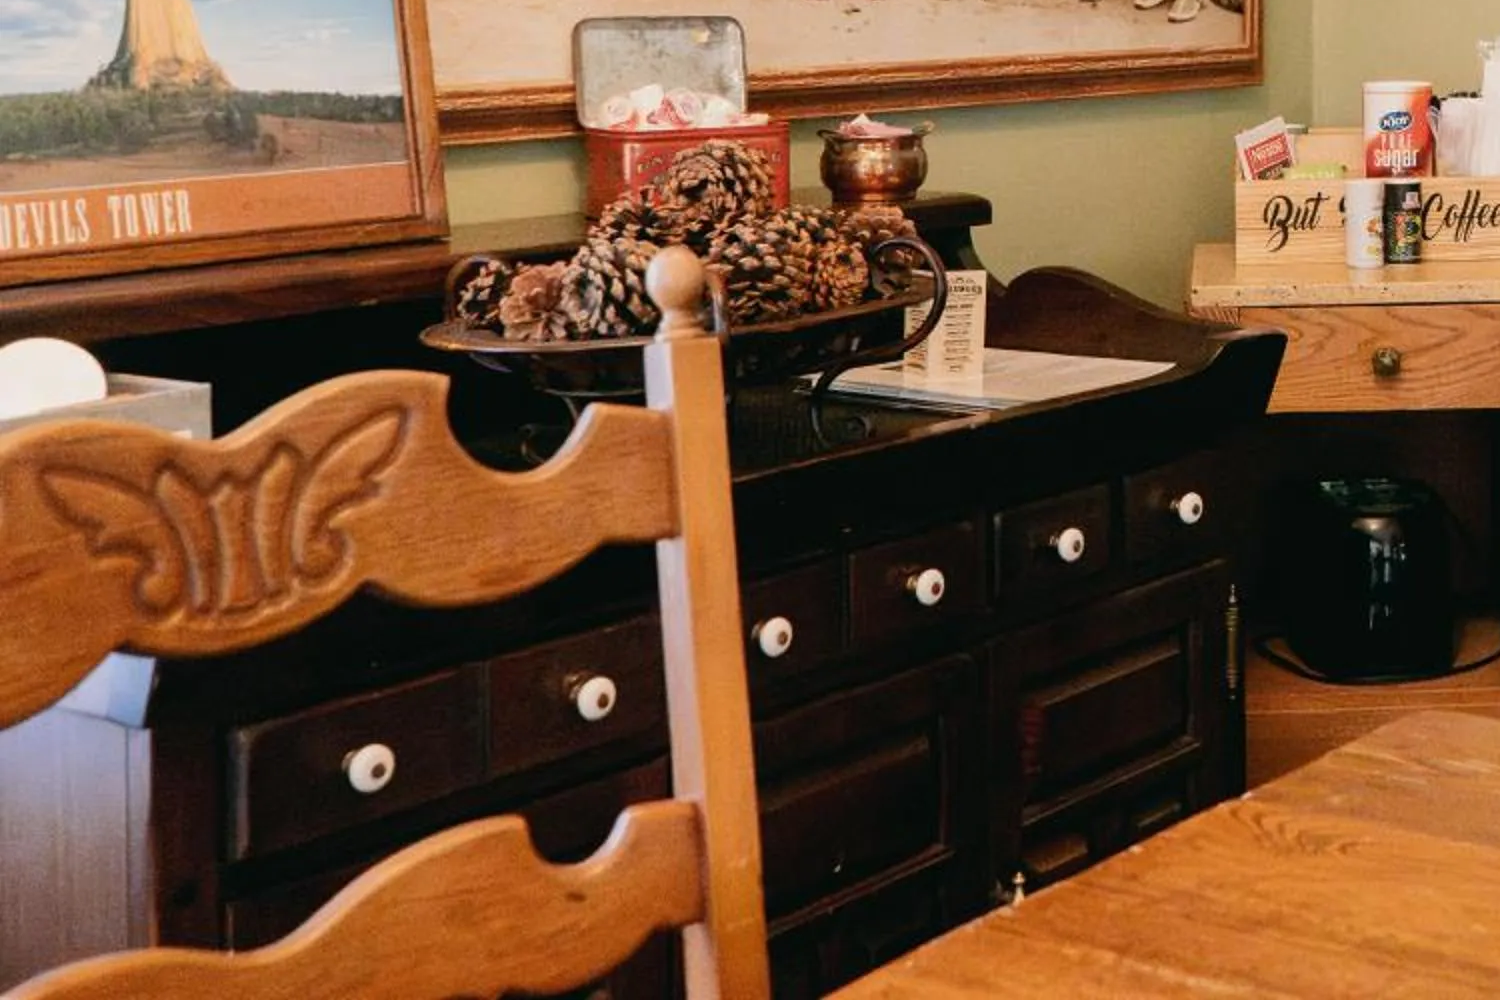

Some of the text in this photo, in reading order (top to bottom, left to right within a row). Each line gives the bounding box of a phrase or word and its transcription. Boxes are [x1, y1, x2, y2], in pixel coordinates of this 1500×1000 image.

[1374, 148, 1419, 174] sugar
[0, 190, 192, 249] DEVILS TOWER
[1263, 191, 1331, 253] But
